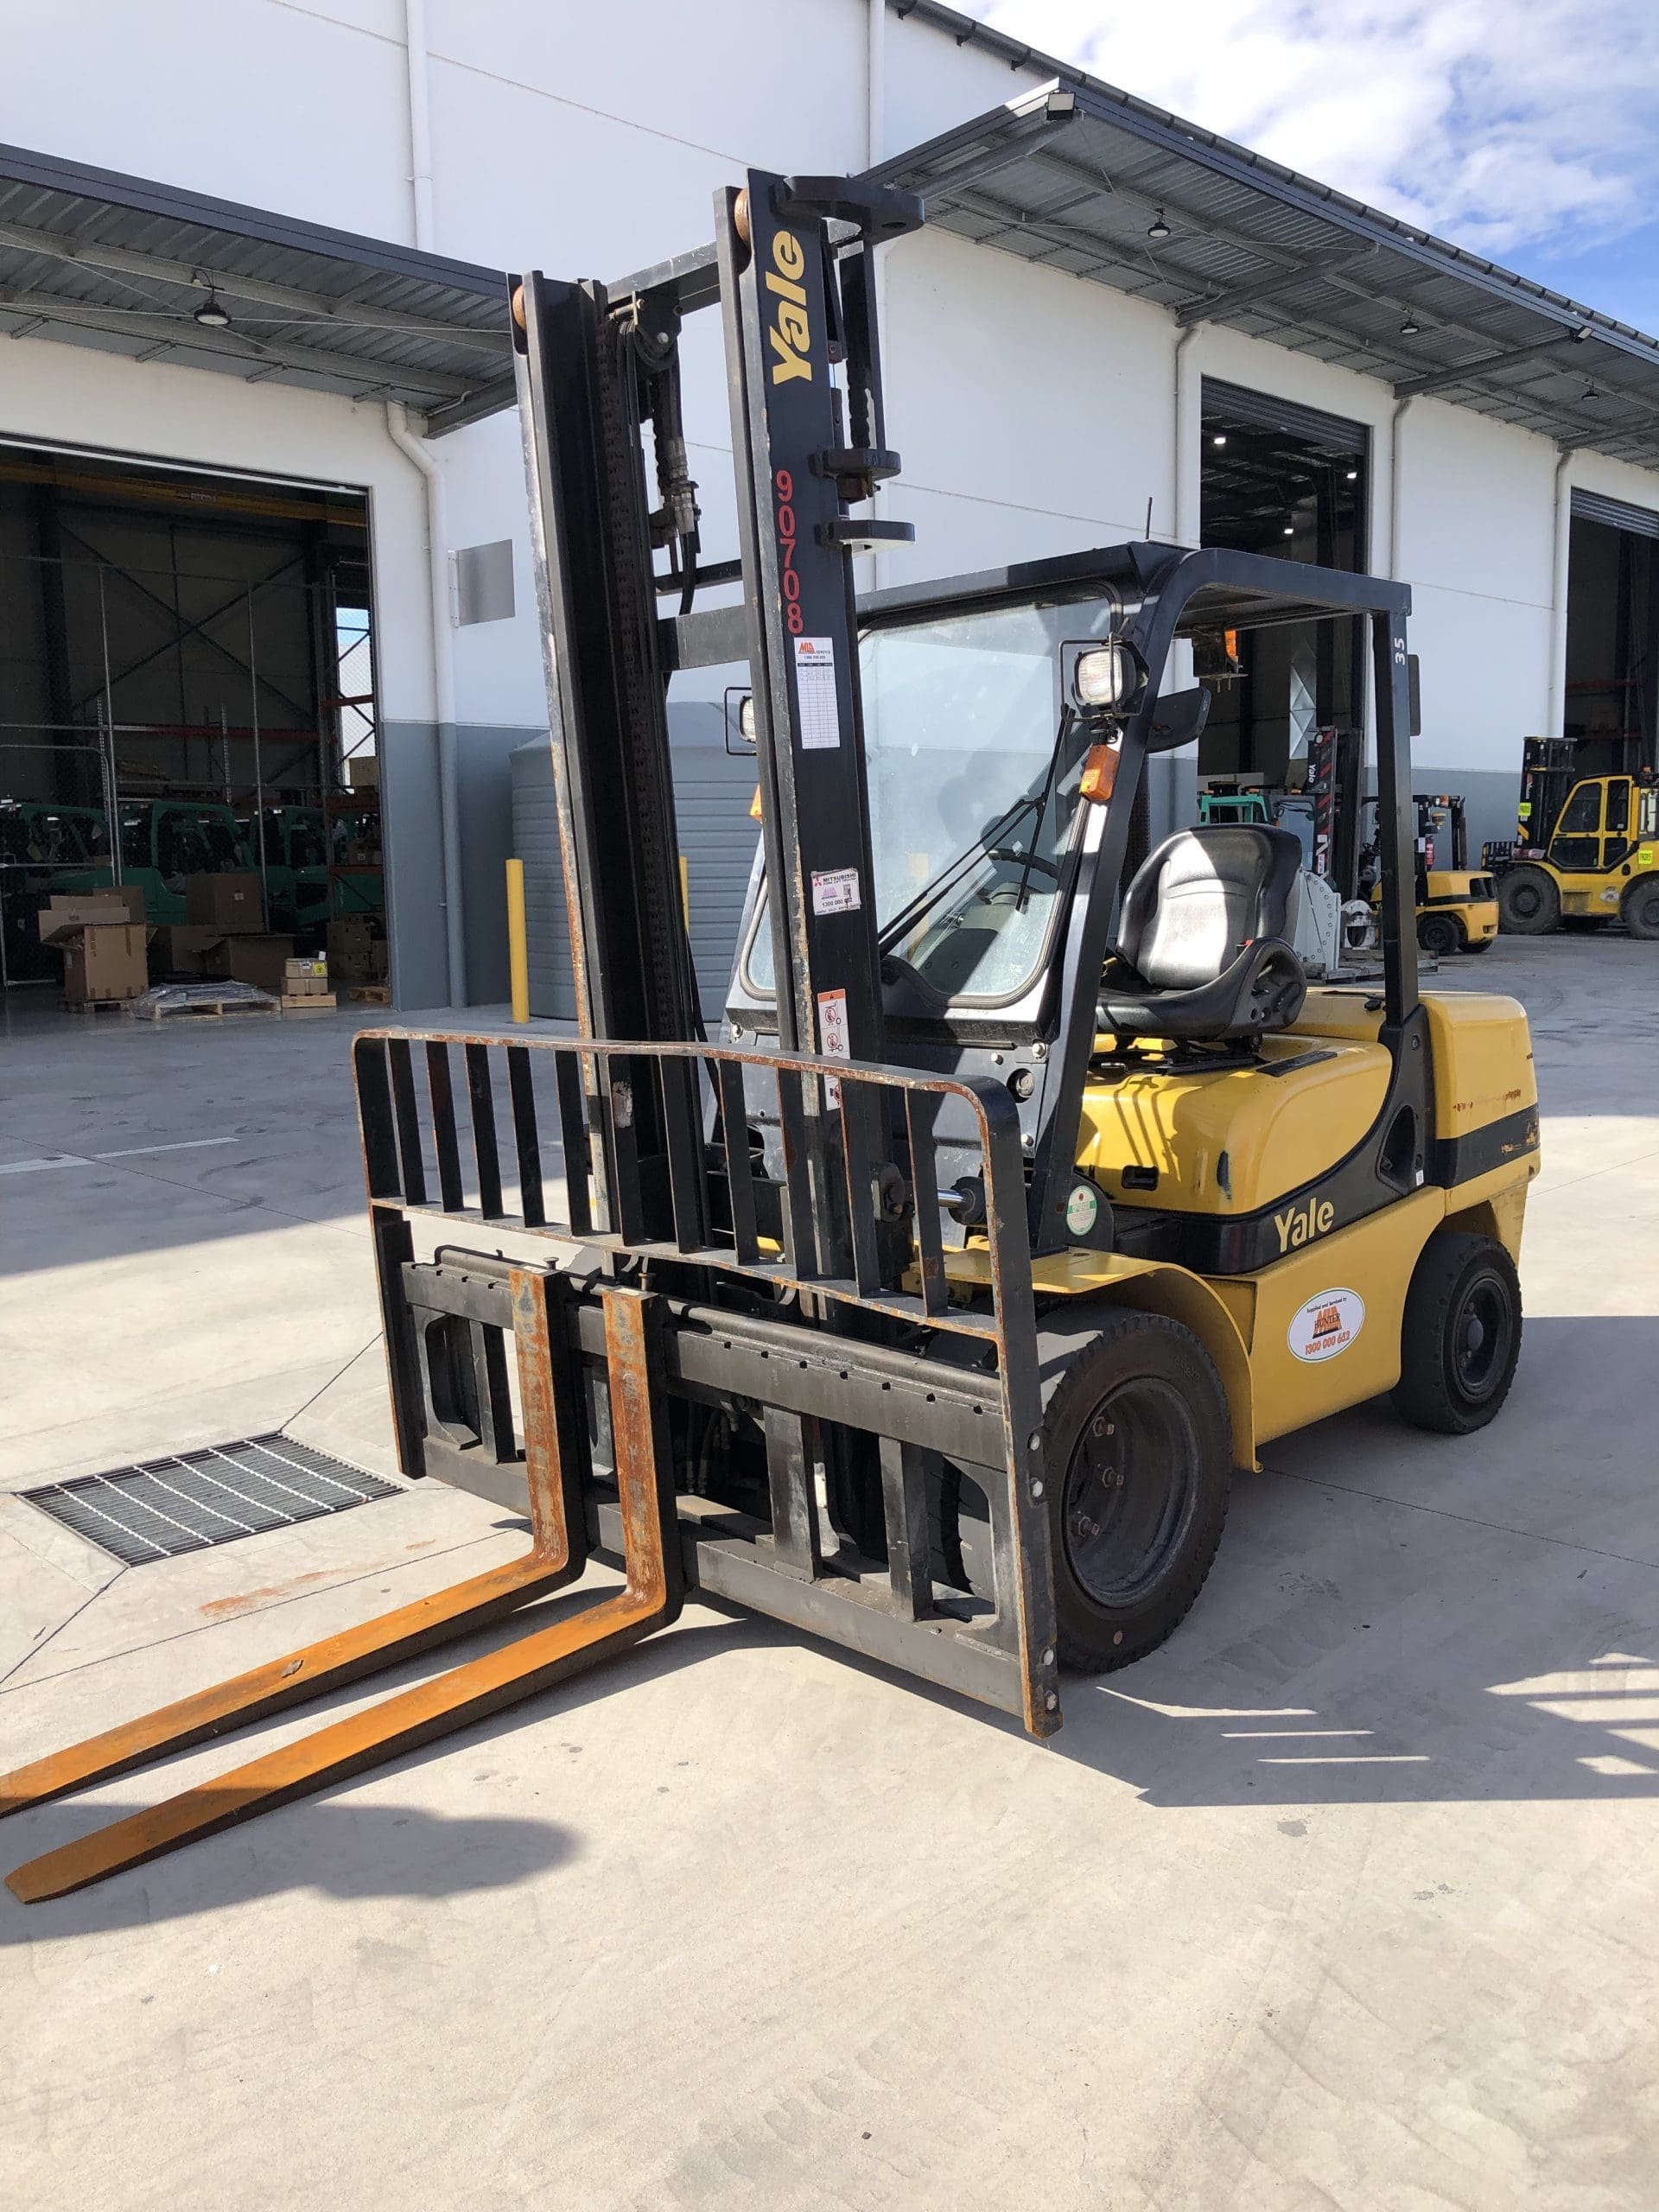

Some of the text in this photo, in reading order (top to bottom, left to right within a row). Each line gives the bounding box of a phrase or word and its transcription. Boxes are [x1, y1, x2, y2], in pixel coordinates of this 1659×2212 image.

[766, 231, 812, 385] Yale
[777, 470, 804, 634] 90708
[1394, 638, 1405, 665] 35
[823, 873, 856, 882] MITSUBISHI
[1274, 1197, 1334, 1253] Yale
[1306, 1304, 1321, 1314] Supplied
[1313, 1313, 1341, 1331] HUNTER
[1306, 1331, 1351, 1355] 1300 000 652
